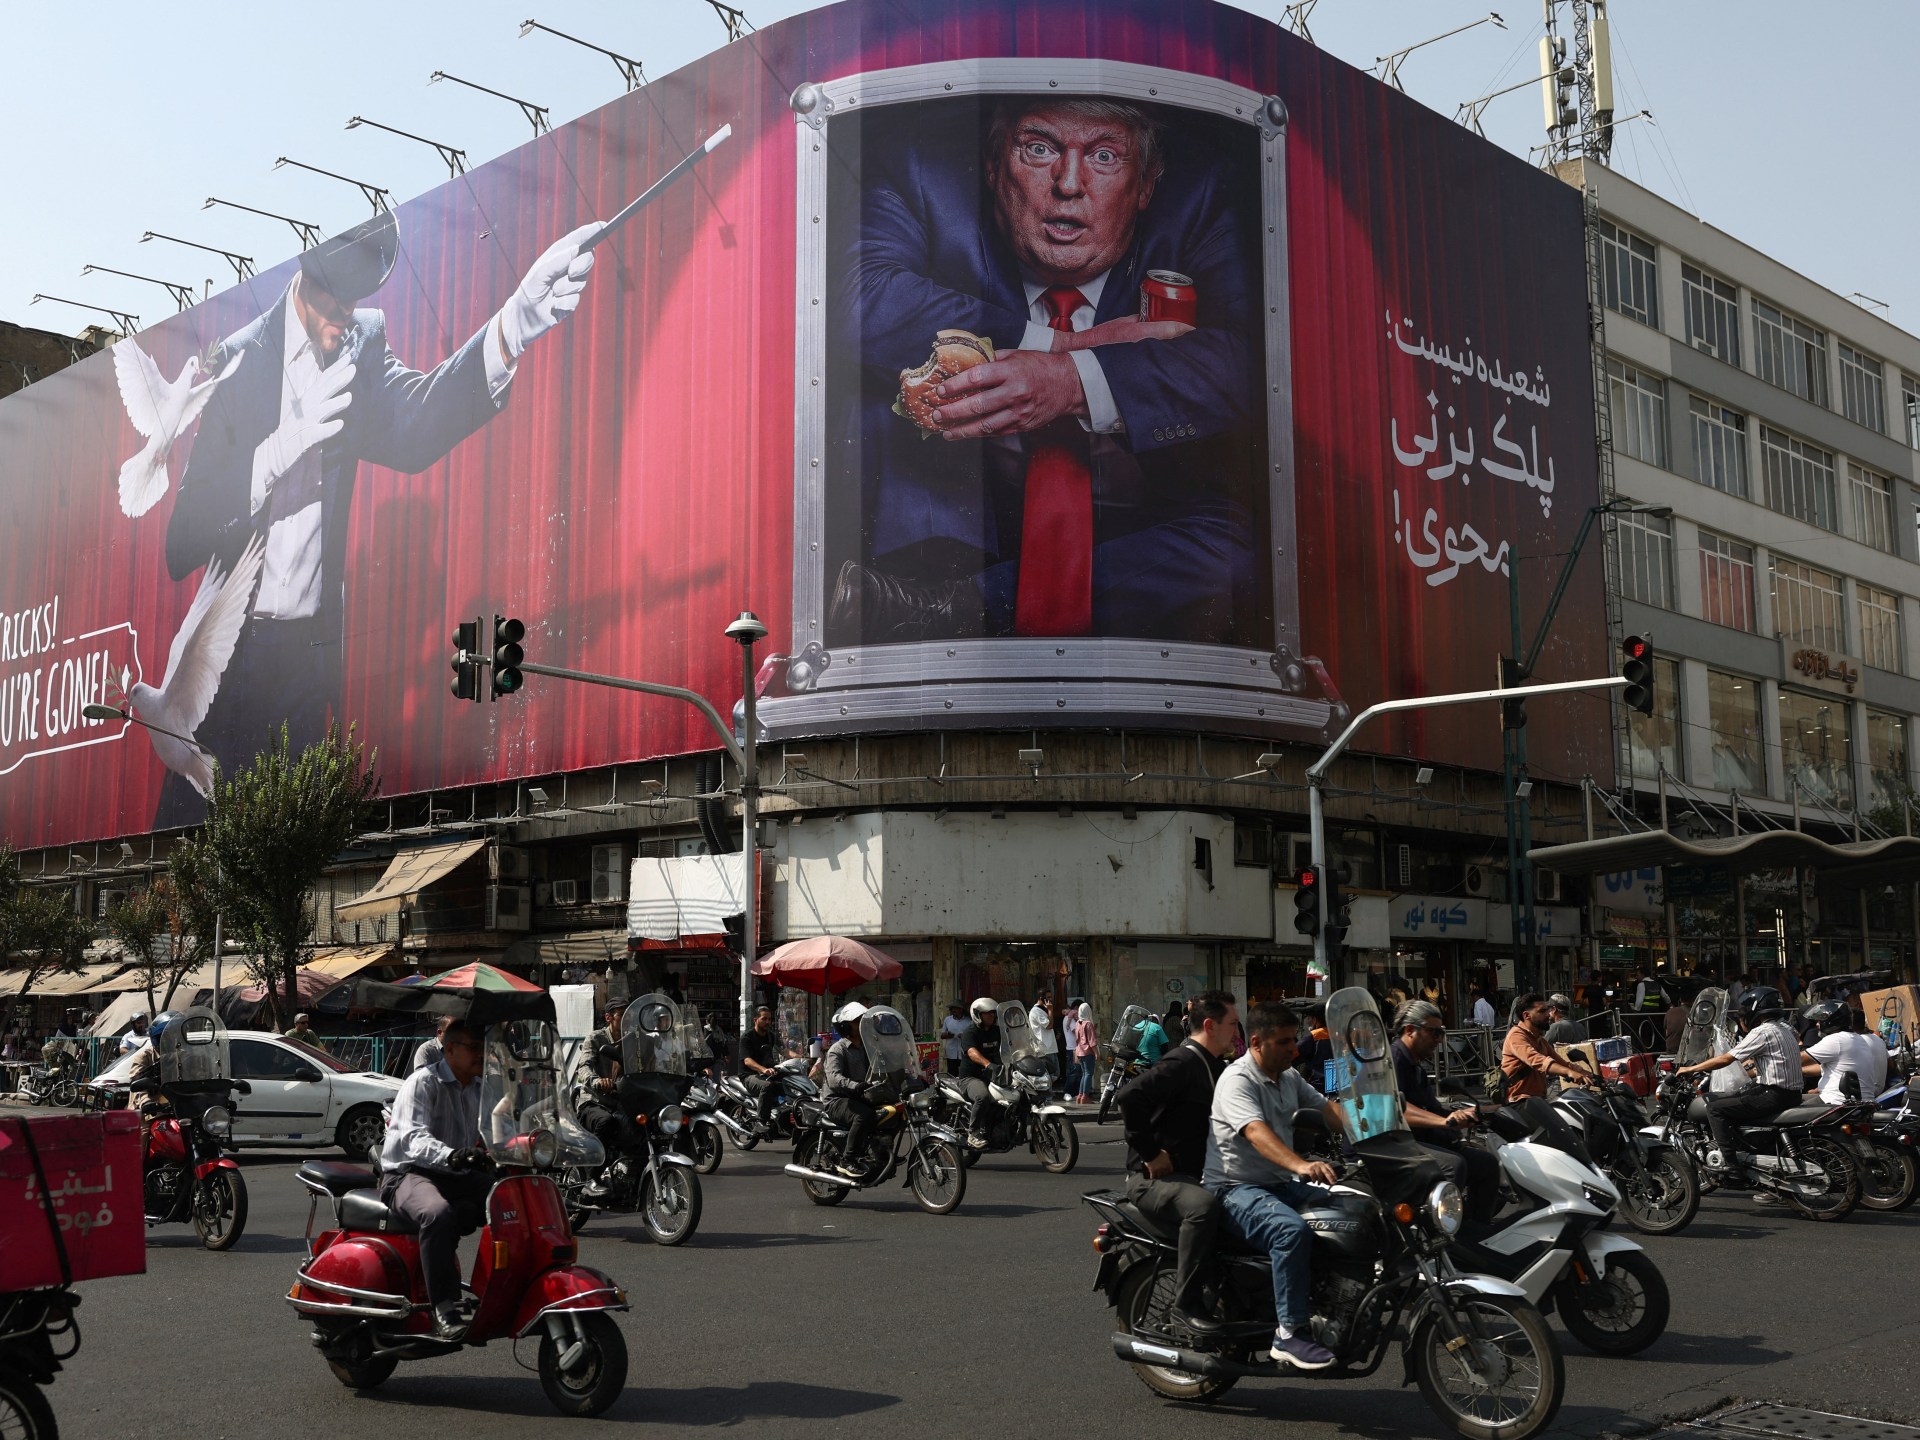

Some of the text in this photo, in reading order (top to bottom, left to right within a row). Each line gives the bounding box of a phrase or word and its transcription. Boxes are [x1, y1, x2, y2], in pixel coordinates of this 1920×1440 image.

[1385, 309, 1551, 407] شعبده نیست!
[1391, 389, 1556, 519] پلک بزنی
[0, 649, 109, 748] U'RE GONE!
[1403, 901, 1468, 933] کوه نور
[55, 1201, 114, 1236] فود
